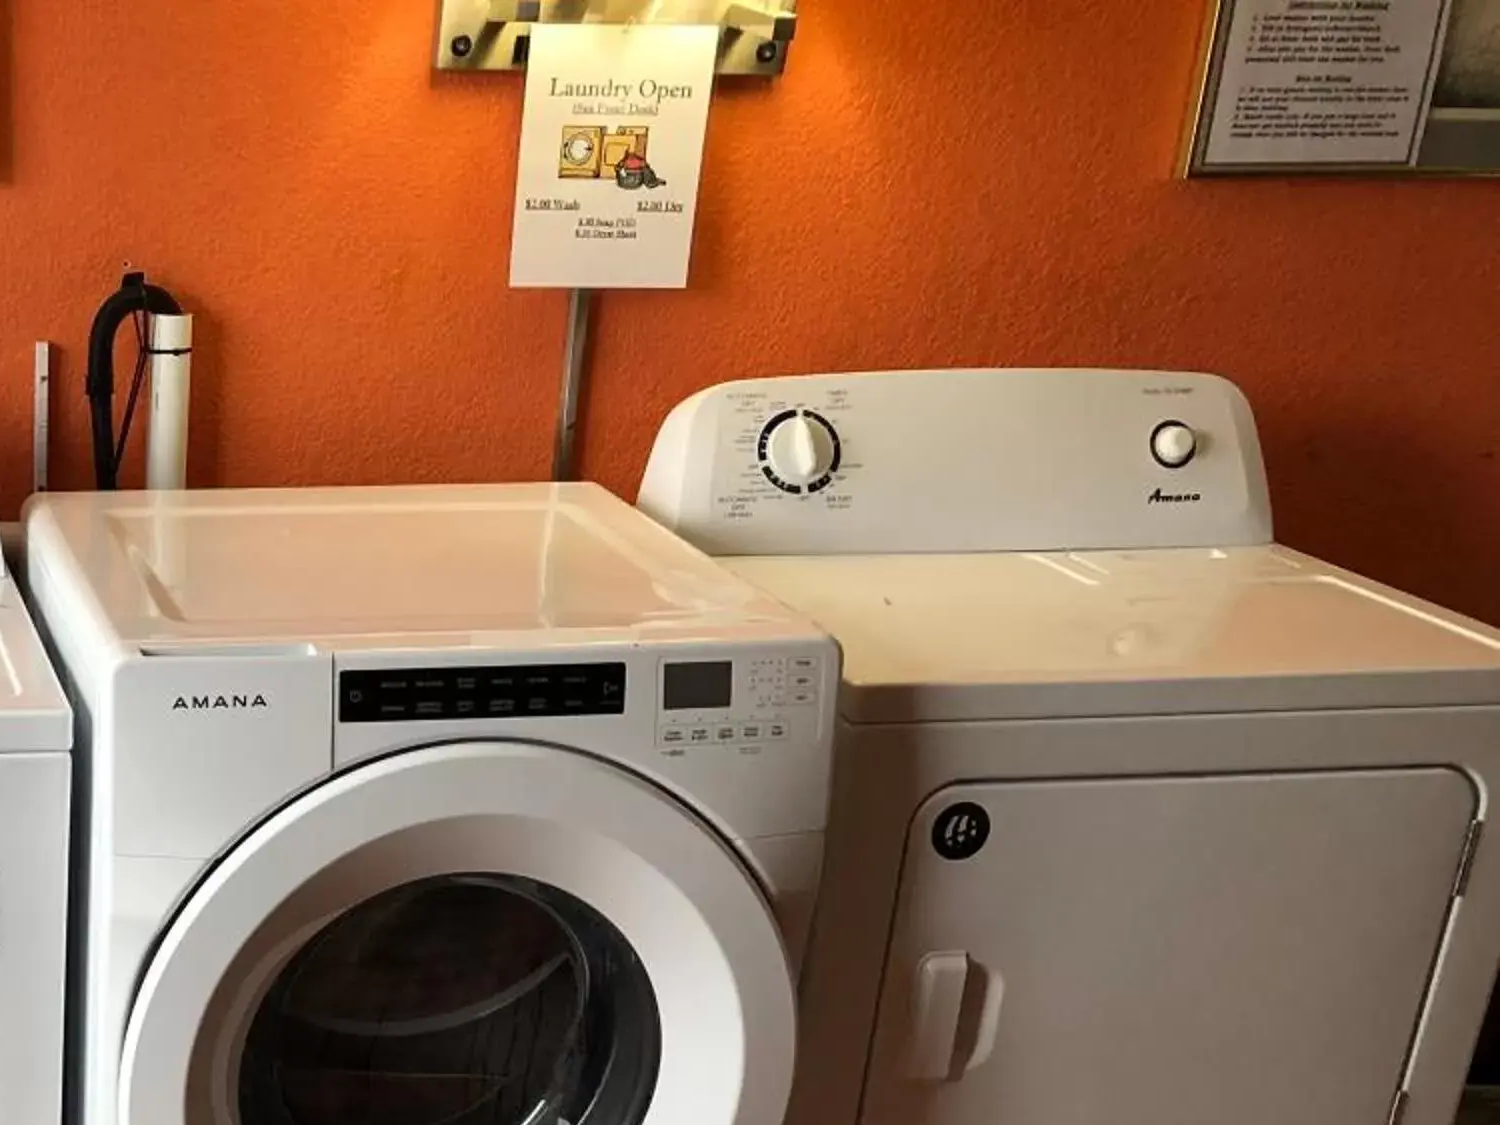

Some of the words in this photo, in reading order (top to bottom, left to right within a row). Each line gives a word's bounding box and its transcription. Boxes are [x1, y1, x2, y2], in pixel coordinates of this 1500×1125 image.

[549, 77, 634, 102] Laundry
[639, 79, 692, 104] Open
[553, 199, 581, 211] Wash
[1148, 487, 1201, 504] Amana
[172, 694, 267, 710] AMANA
